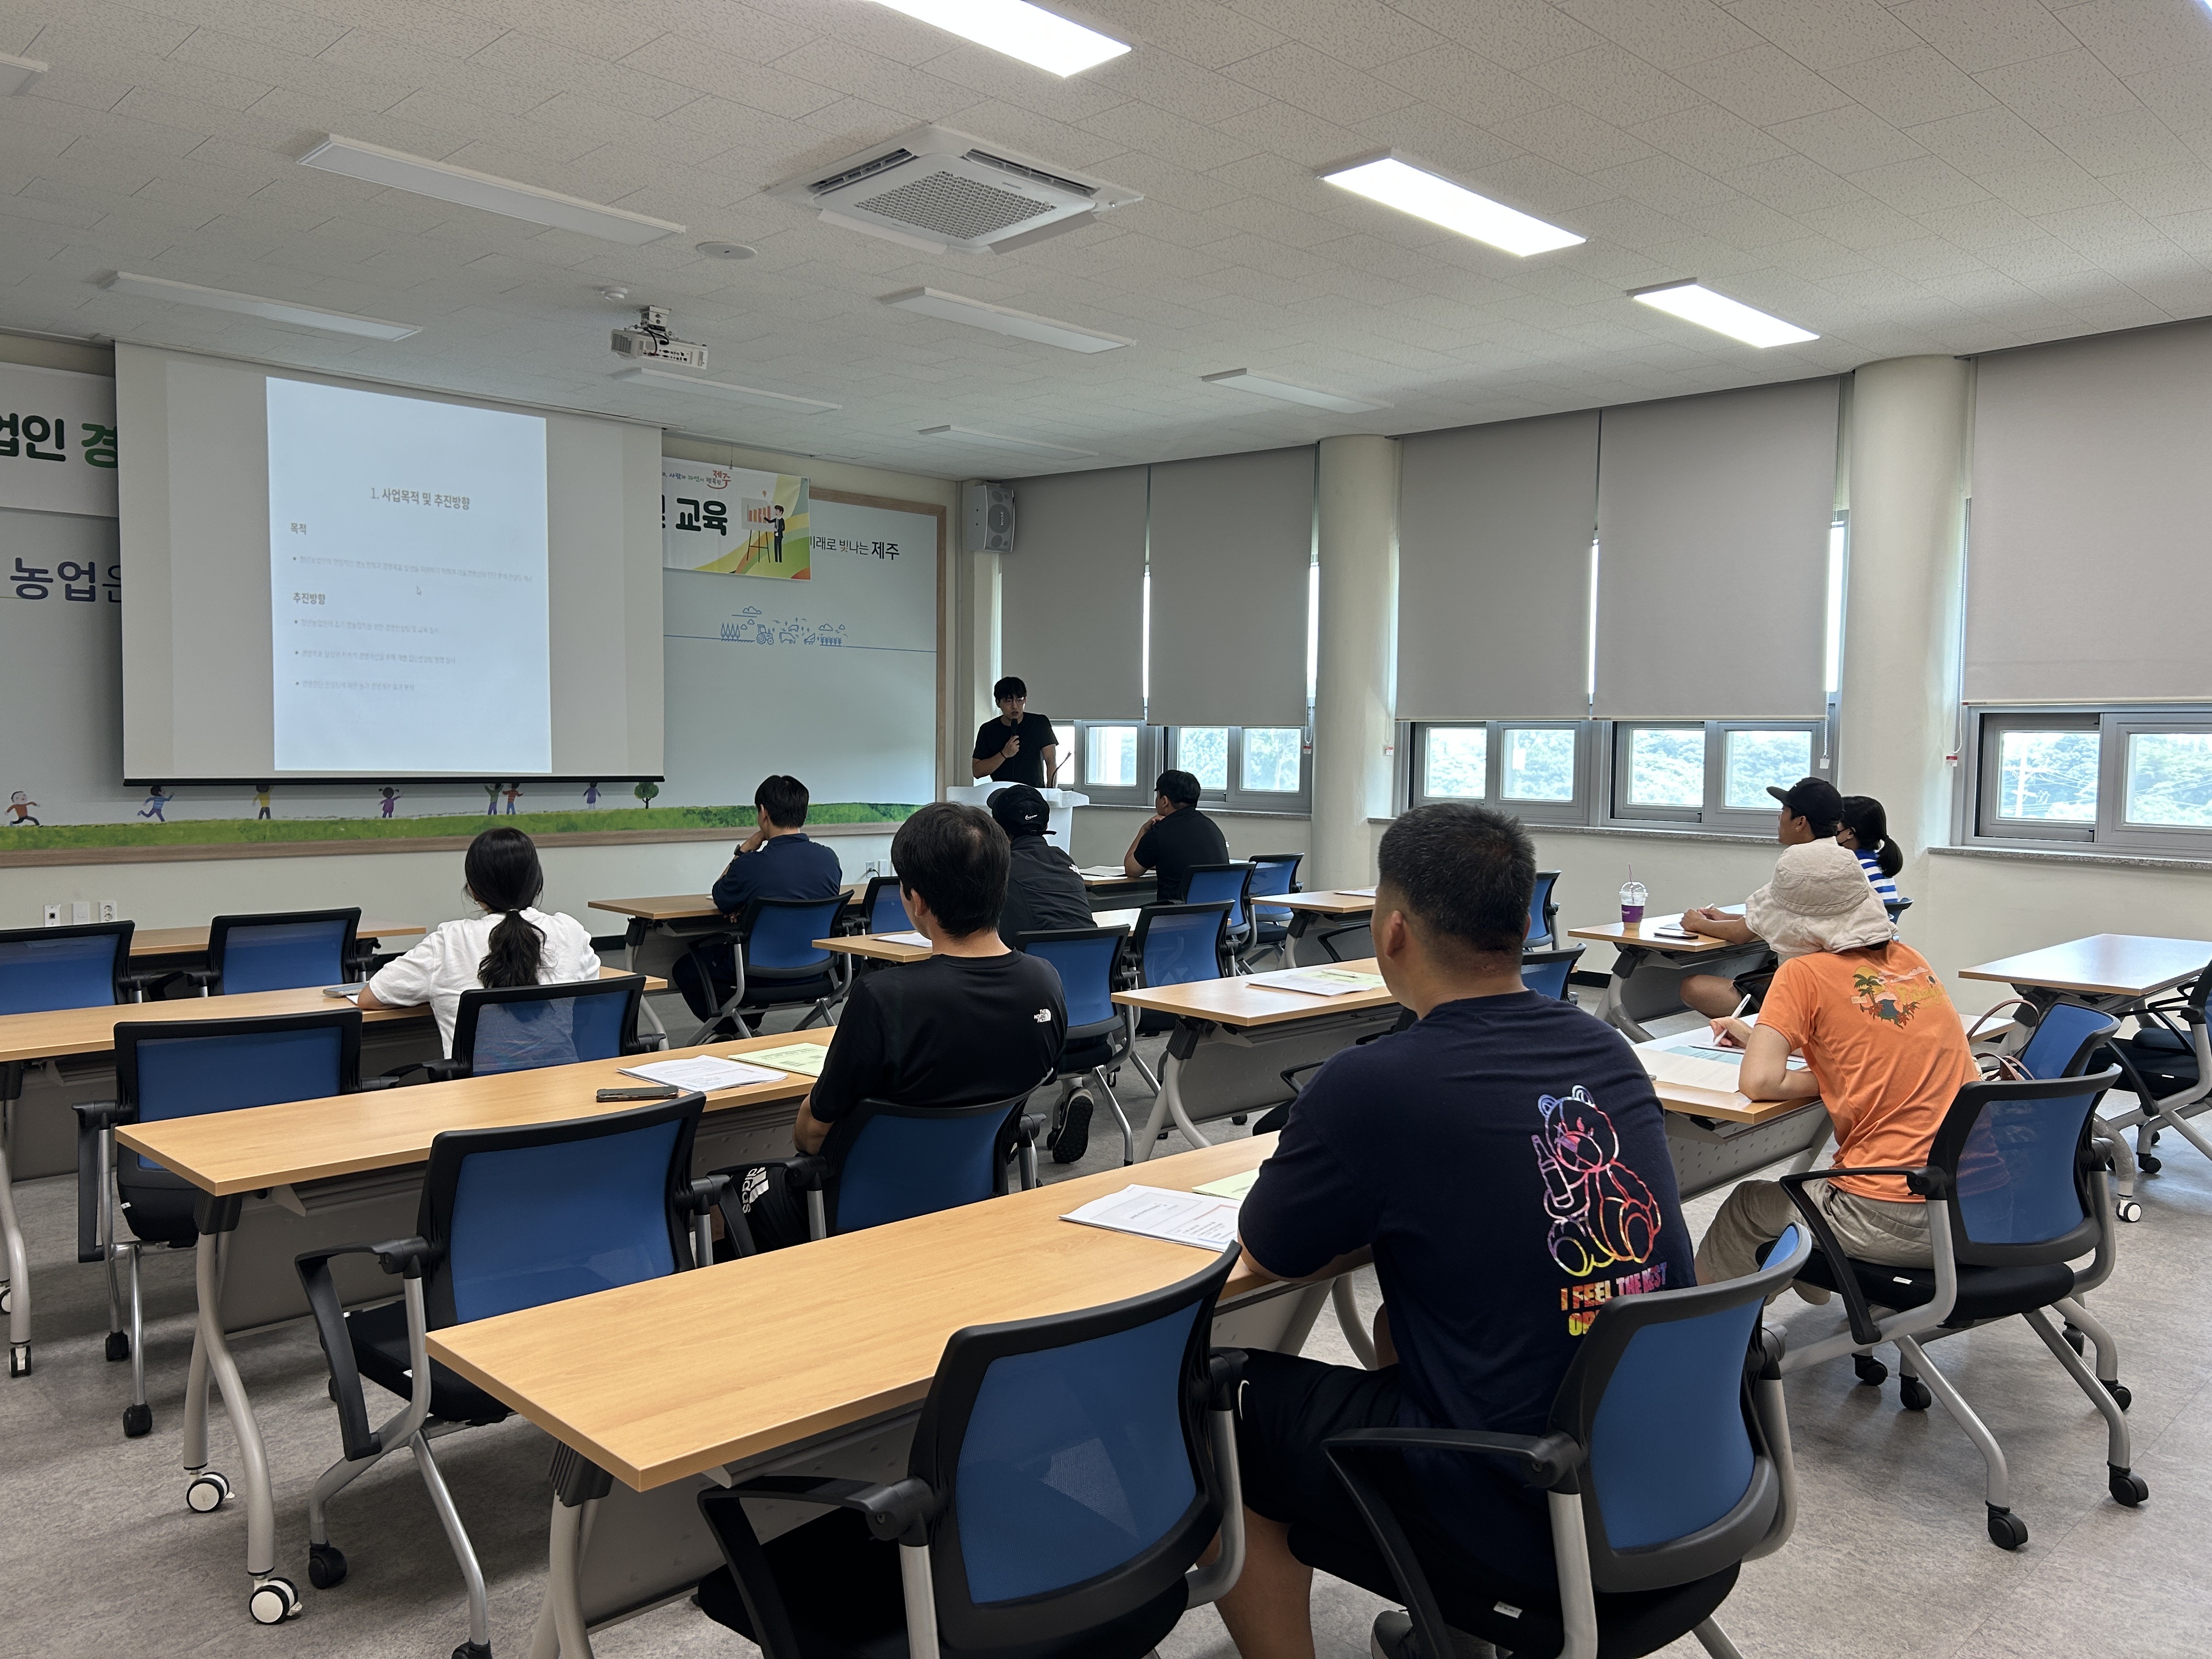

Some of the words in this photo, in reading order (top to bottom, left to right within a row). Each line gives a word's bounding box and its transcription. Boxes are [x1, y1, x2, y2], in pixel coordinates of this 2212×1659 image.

[711, 470, 731, 489] 제주
[371, 488, 380, 499] 1.
[382, 488, 419, 504] 사업목적
[422, 492, 431, 506] 및
[434, 494, 470, 510] 추진방향
[675, 498, 727, 536] 교육
[291, 523, 306, 535] 목적
[872, 541, 900, 560] 제주
[293, 592, 325, 605] 추진방향
[742, 1168, 758, 1213] didas
[1561, 1288, 1568, 1311] I
[1572, 1280, 1613, 1309] FEEL
[1616, 1273, 1642, 1296] THE
